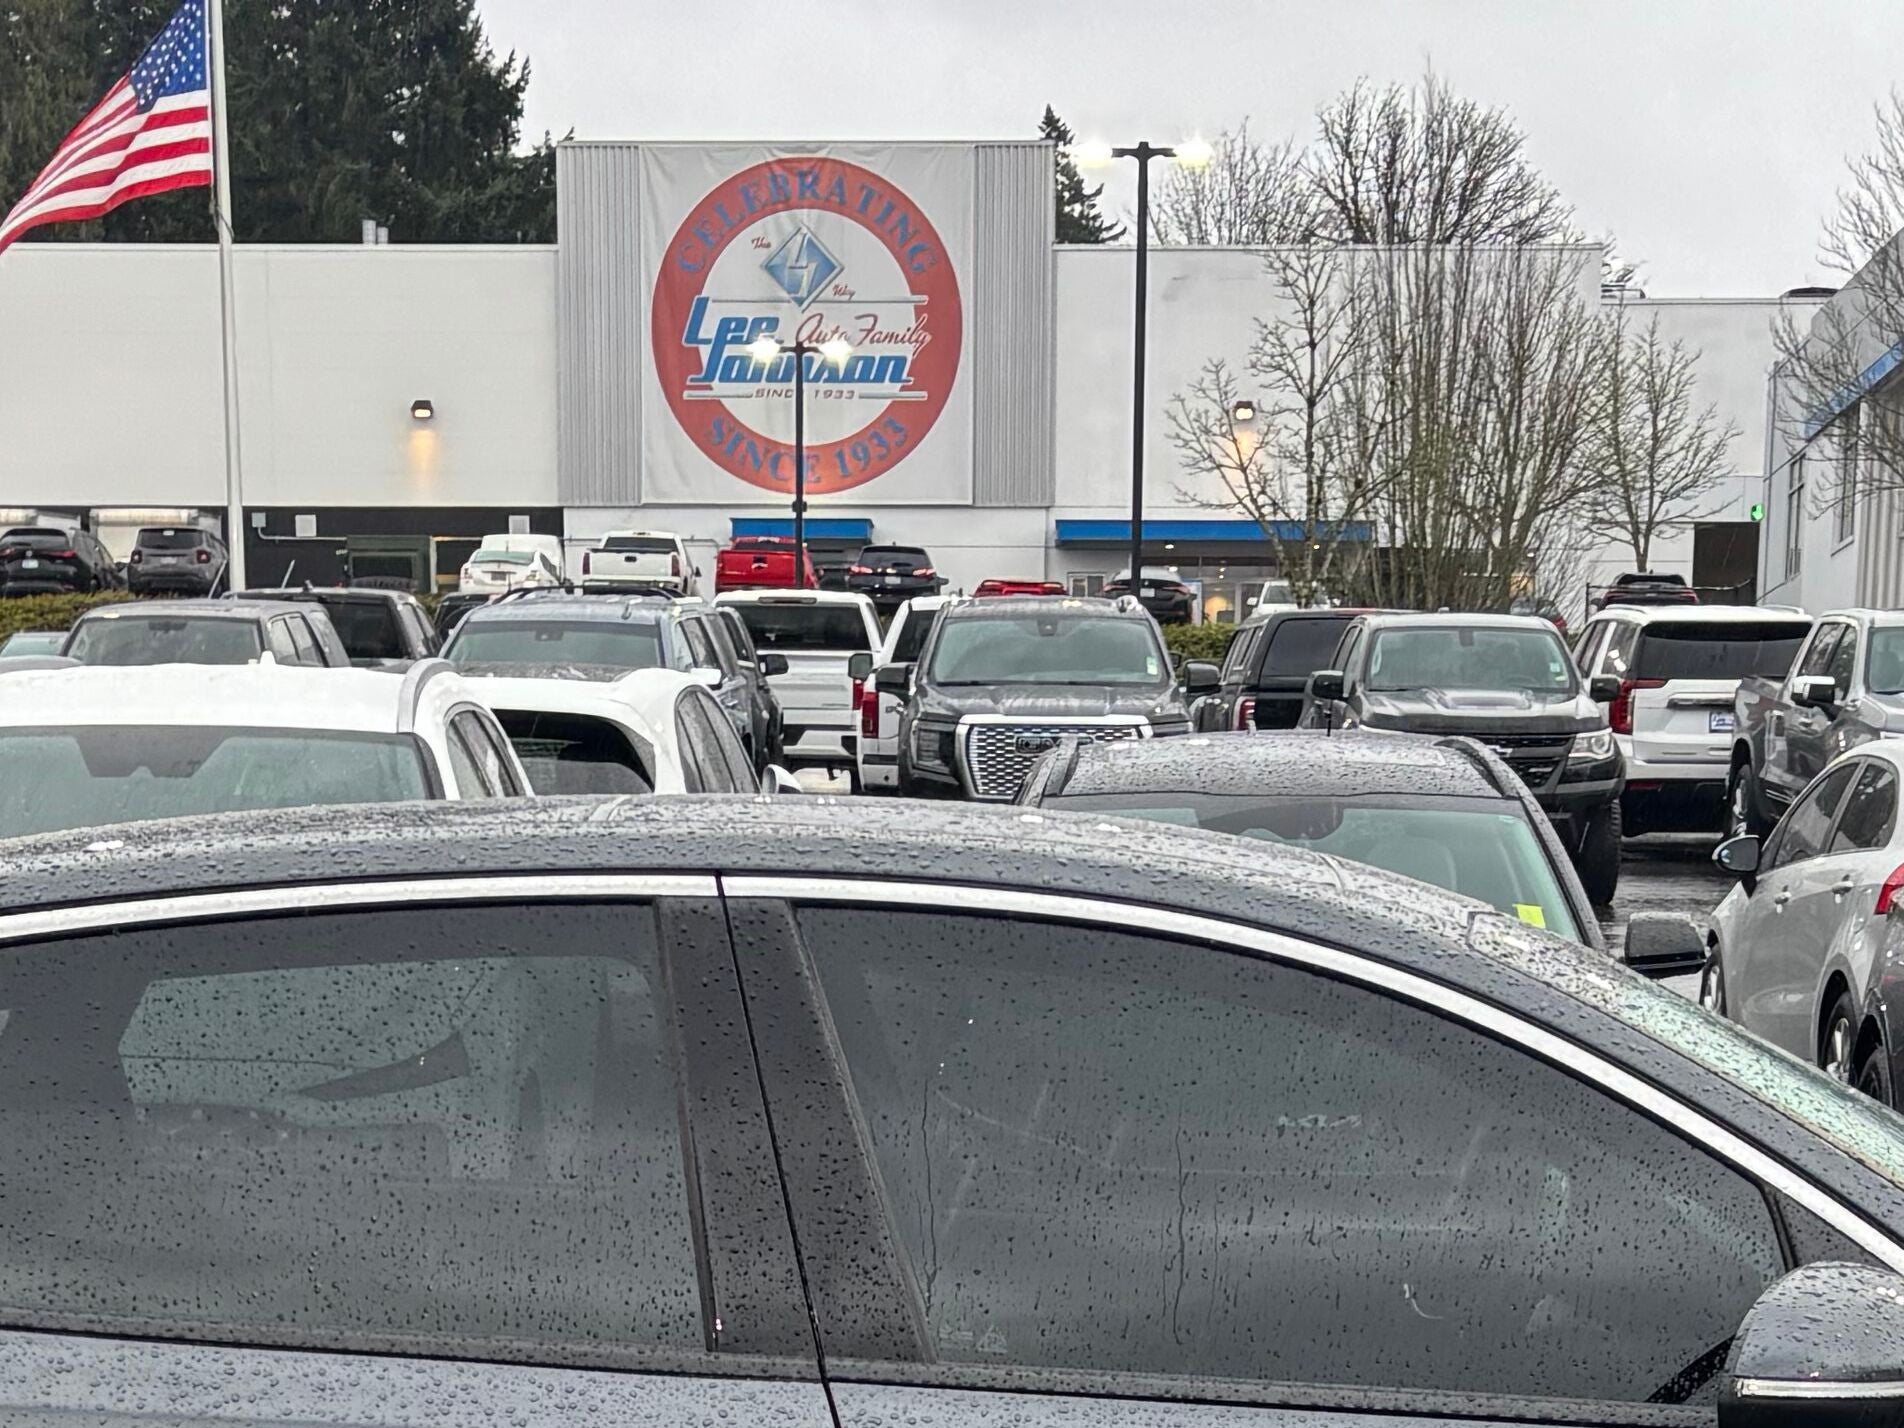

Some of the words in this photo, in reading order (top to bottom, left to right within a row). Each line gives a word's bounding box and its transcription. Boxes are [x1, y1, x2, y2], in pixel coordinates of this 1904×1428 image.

[678, 169, 936, 274] CELEBRATING
[684, 296, 784, 345] Lee
[854, 313, 932, 357] Family
[755, 388, 803, 399] SINC
[814, 389, 854, 400] 1933
[704, 416, 822, 483] SINCE
[835, 416, 907, 477] 1933
